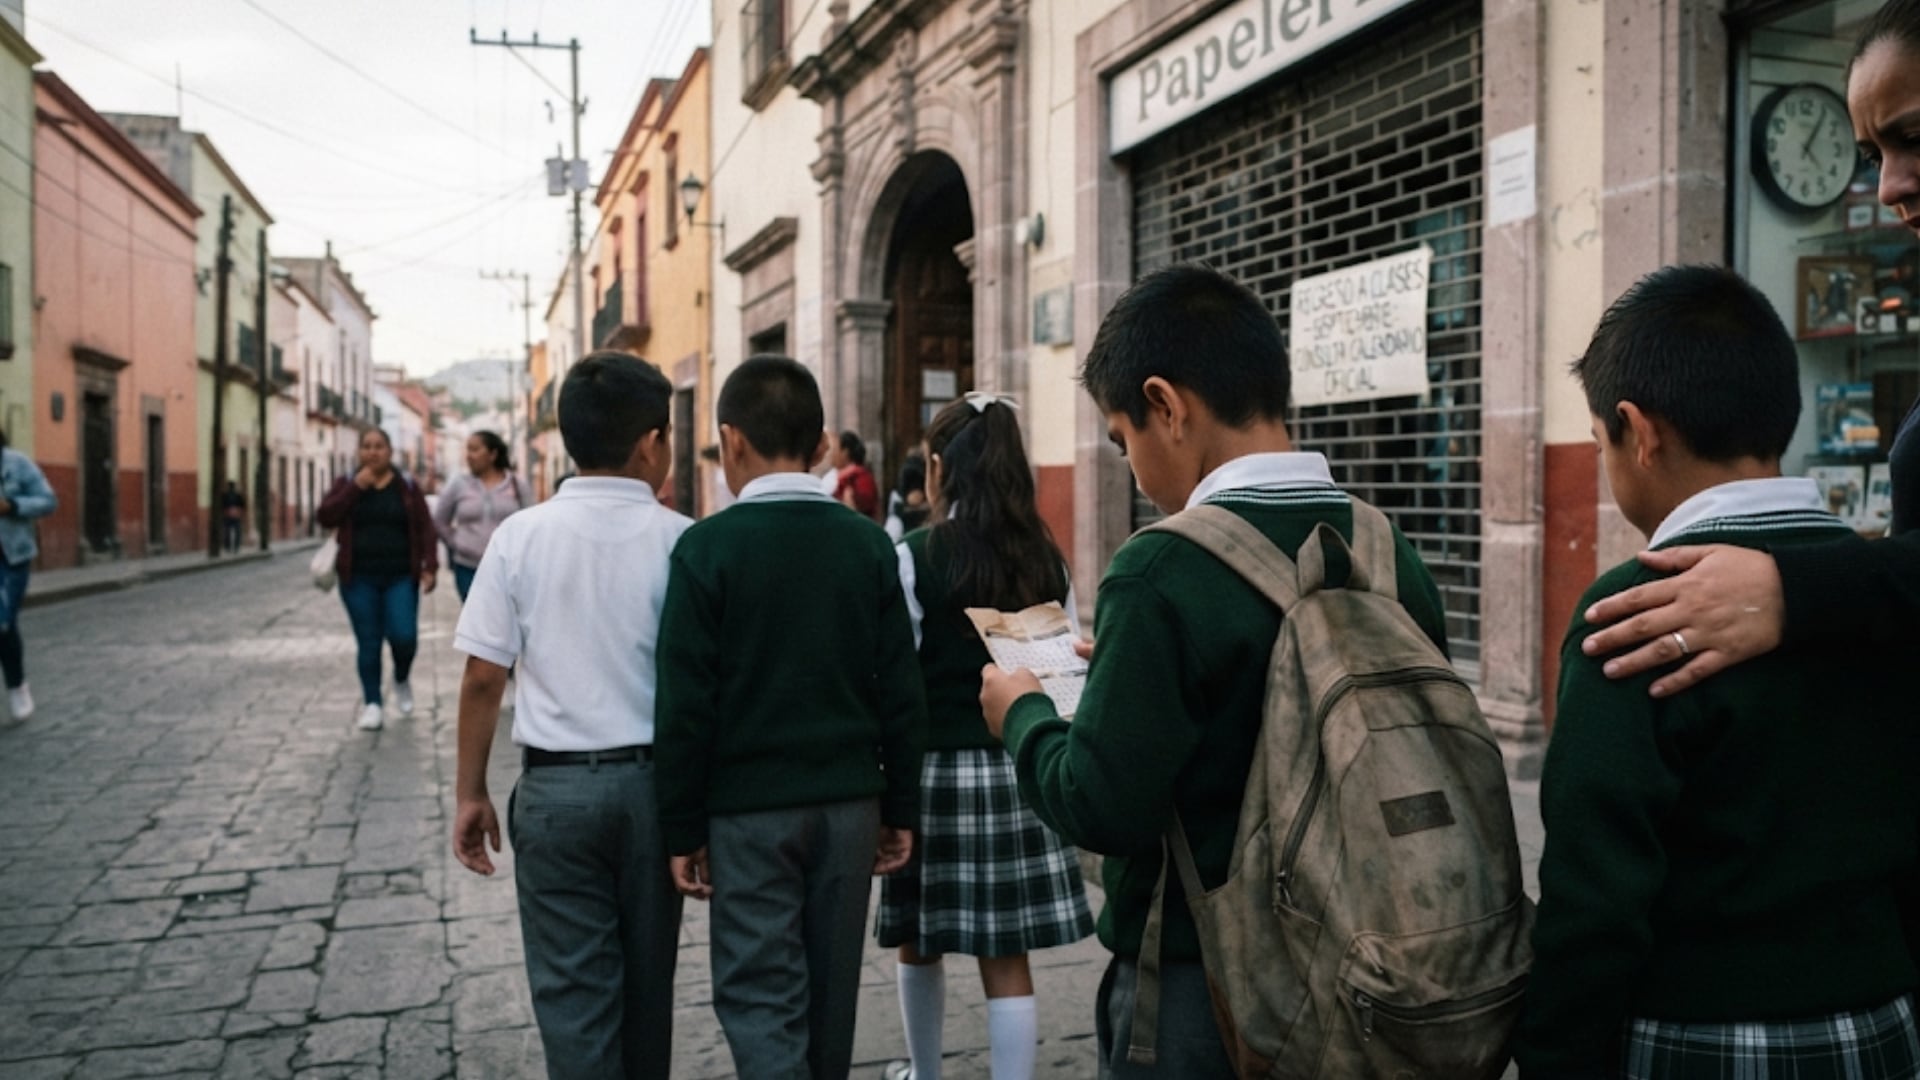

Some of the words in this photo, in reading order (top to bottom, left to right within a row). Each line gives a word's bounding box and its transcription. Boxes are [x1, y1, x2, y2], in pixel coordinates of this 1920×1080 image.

[1137, 0, 1370, 123] Papele
[1358, 275, 1367, 297] A
[1371, 259, 1425, 298] CLASES
